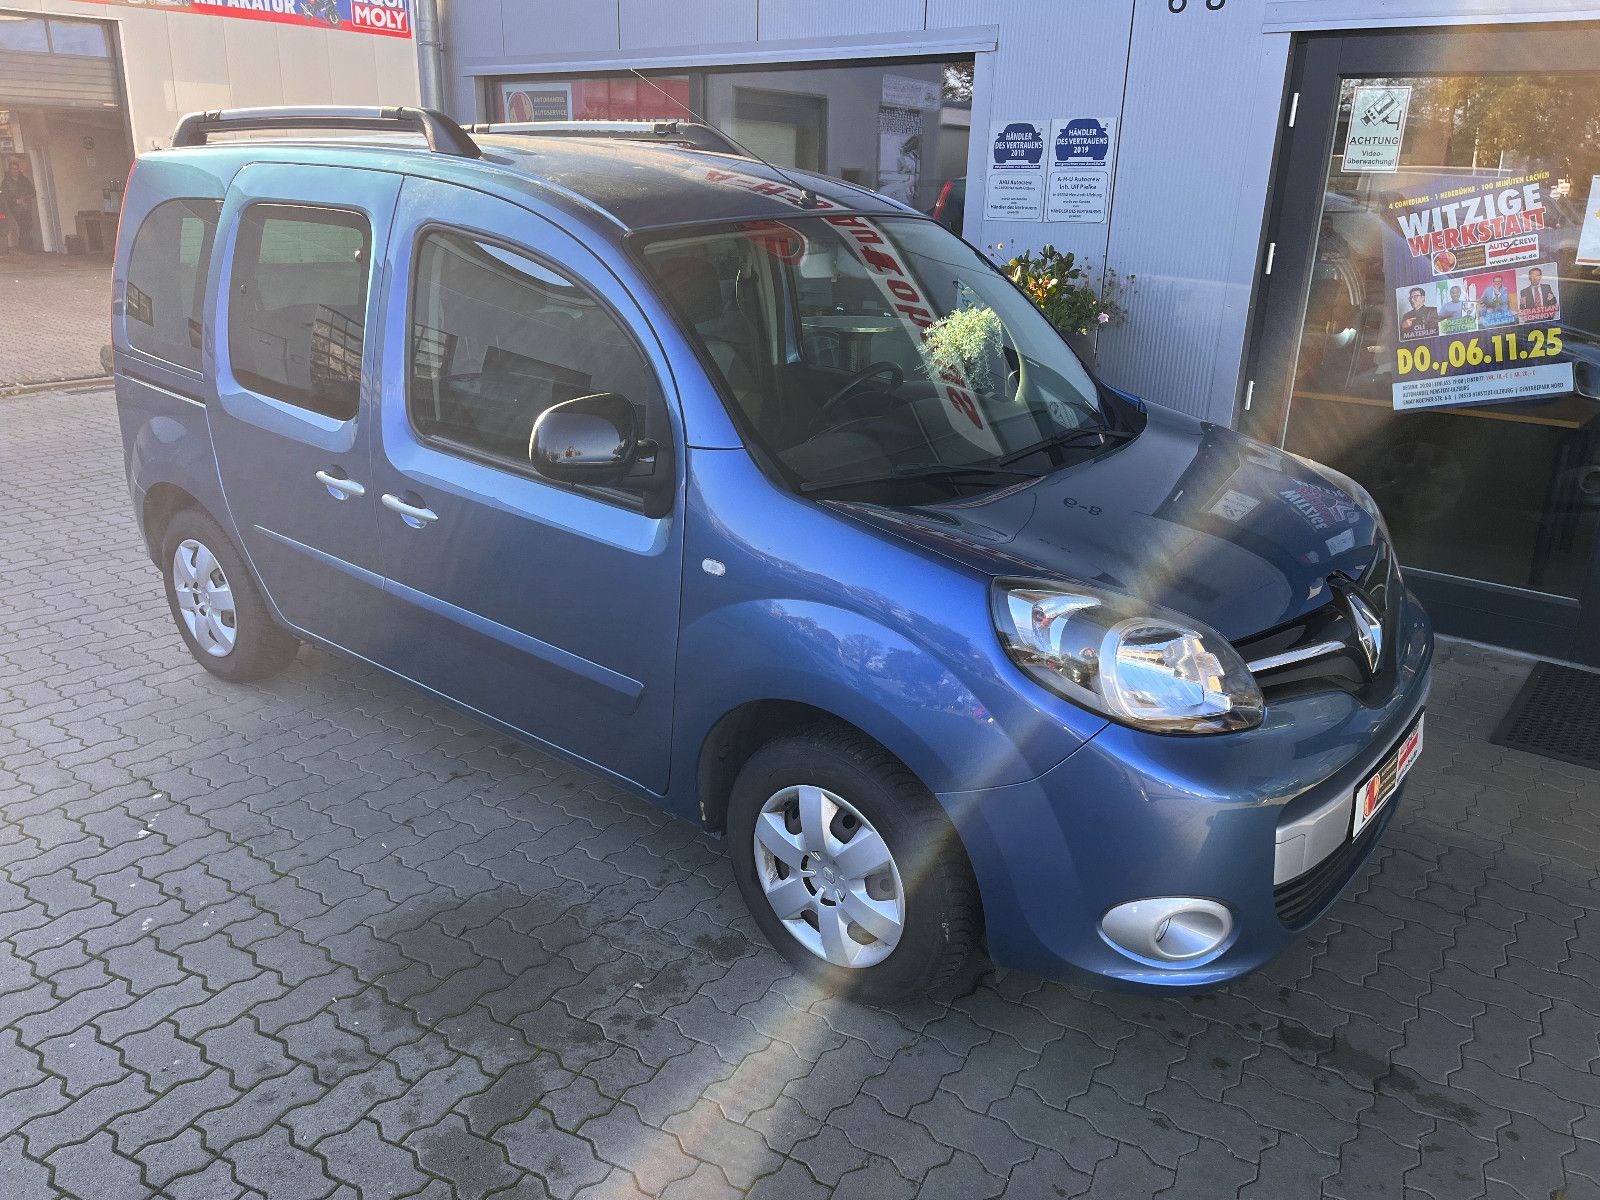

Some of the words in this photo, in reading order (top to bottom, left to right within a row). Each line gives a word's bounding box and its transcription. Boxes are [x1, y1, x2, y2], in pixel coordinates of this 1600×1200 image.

[354, 5, 405, 30] MOLY
[1006, 131, 1033, 141] HÄNDLER
[1069, 127, 1097, 137] HÄNDLER
[995, 141, 1006, 150] DES
[1006, 141, 1043, 149] VERTRAUENS
[1056, 138, 1068, 146] DES
[1069, 137, 1108, 145] VERTRAUENS
[1350, 136, 1399, 145] ACHTUNG
[1073, 146, 1089, 154] 2019
[1347, 158, 1395, 166] überwachung!
[1394, 195, 1430, 209] COMEDIANS
[1481, 182, 1494, 191] 100
[1495, 176, 1525, 188] MINUTEN
[1526, 170, 1550, 182] LACHEN
[1397, 182, 1544, 239] WITZIGE
[1407, 207, 1546, 257] WERKSTATT
[1489, 241, 1510, 250] AUTO
[1513, 236, 1537, 246] CREW
[1489, 252, 1537, 265] www.a-h-u.de
